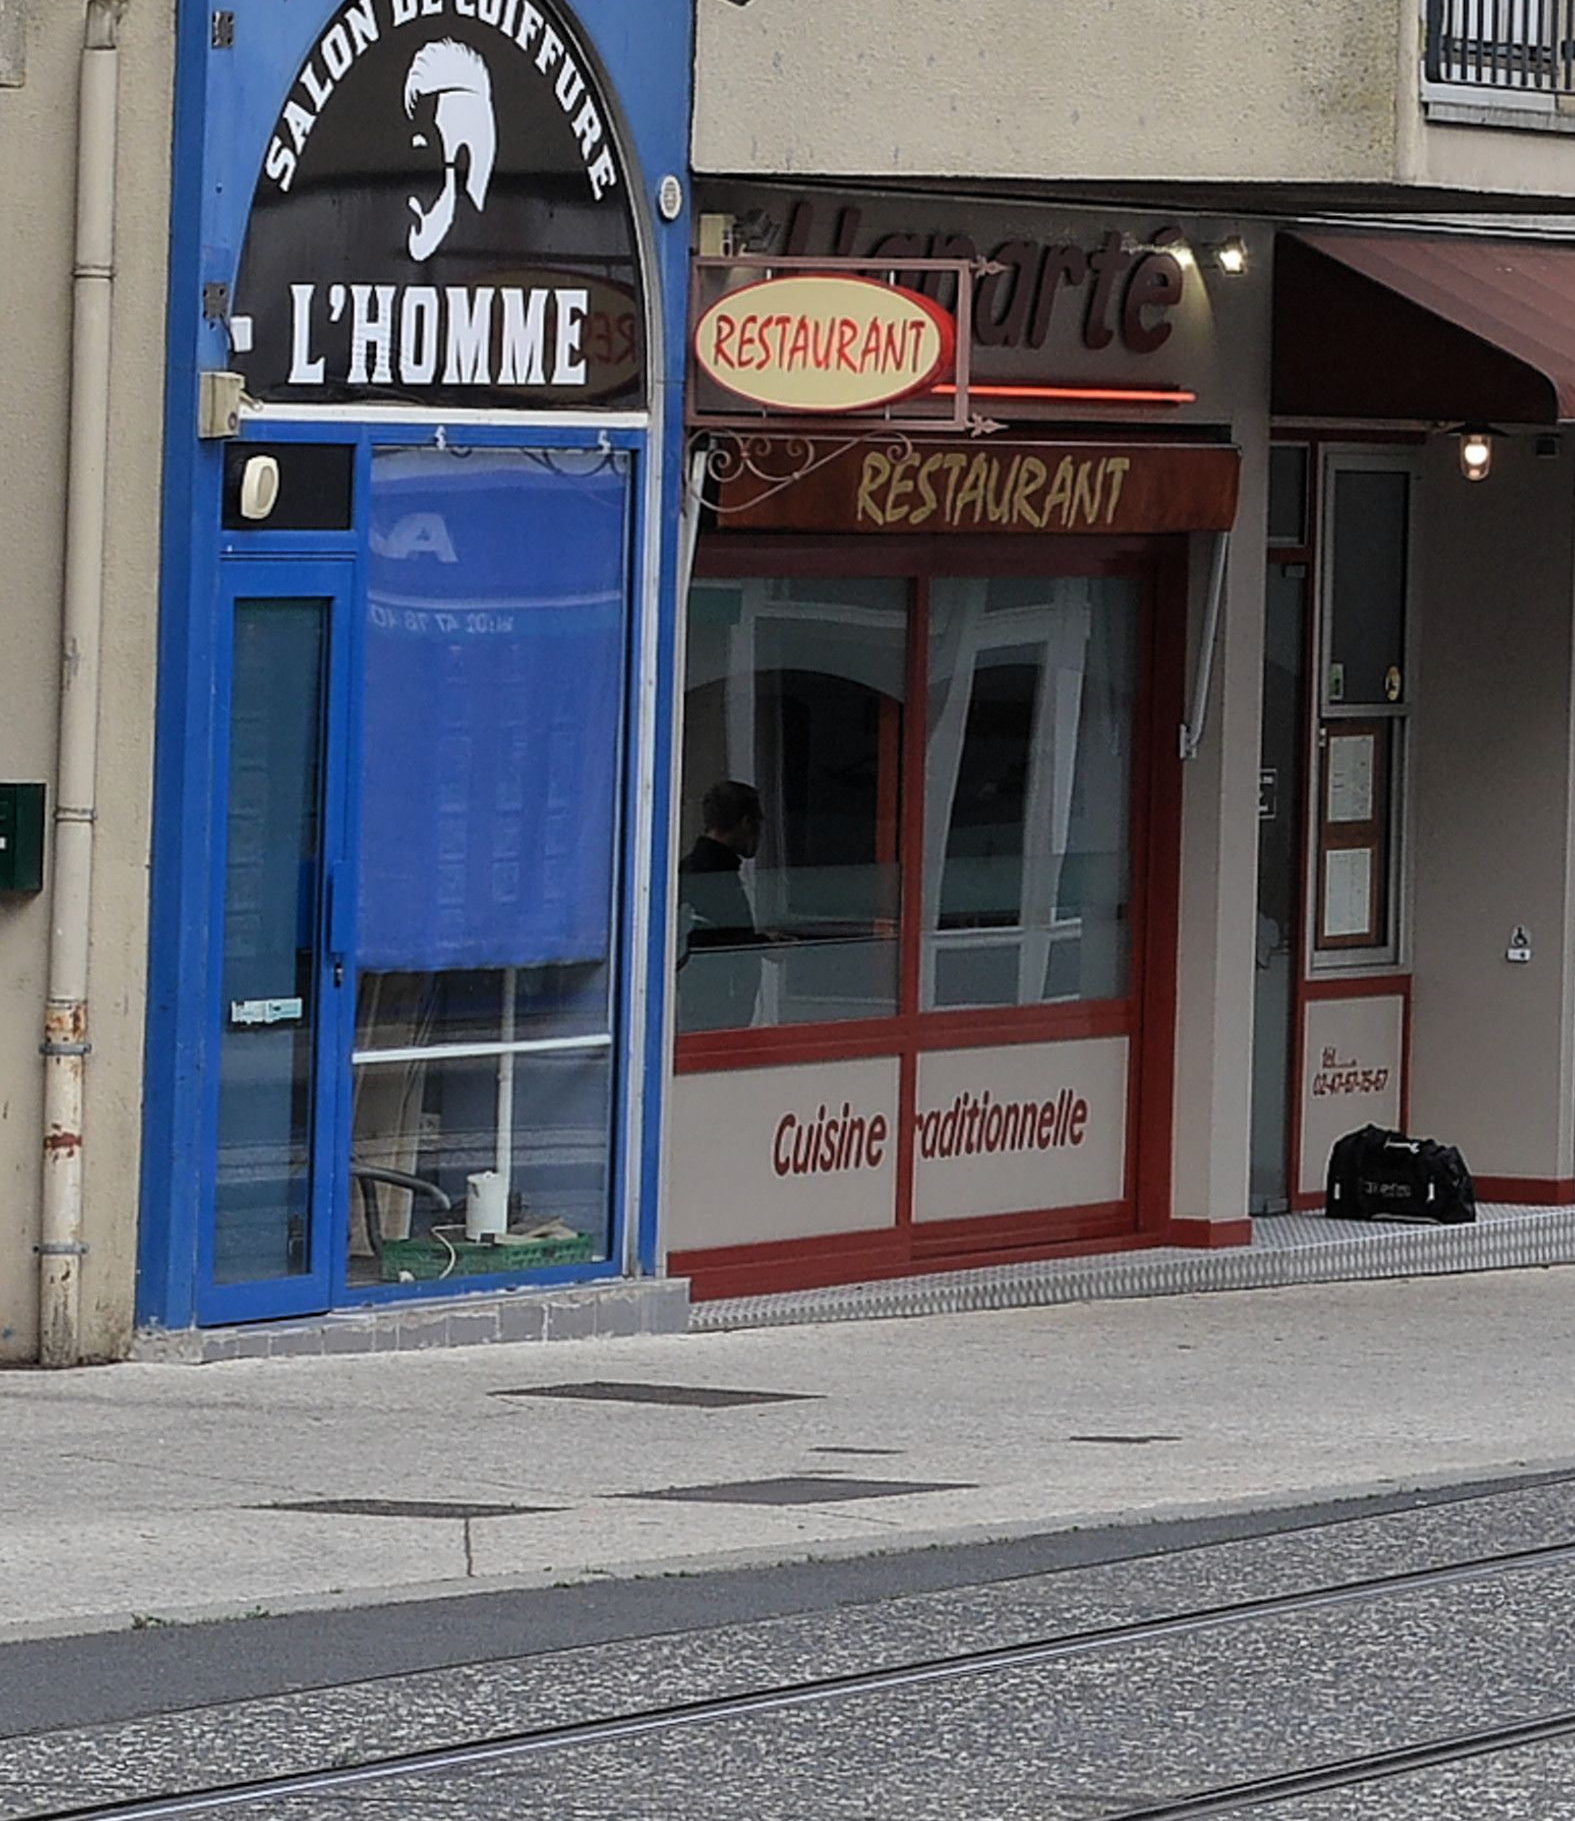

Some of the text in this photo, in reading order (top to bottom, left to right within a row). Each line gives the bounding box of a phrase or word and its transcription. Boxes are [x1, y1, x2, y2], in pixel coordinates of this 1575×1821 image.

[288, 284, 588, 385] L'HOMME
[712, 315, 925, 376] RESTAURANT
[857, 450, 1130, 528] RESTAURANT
[773, 1088, 1088, 1178] Cuisine raditionnelle
